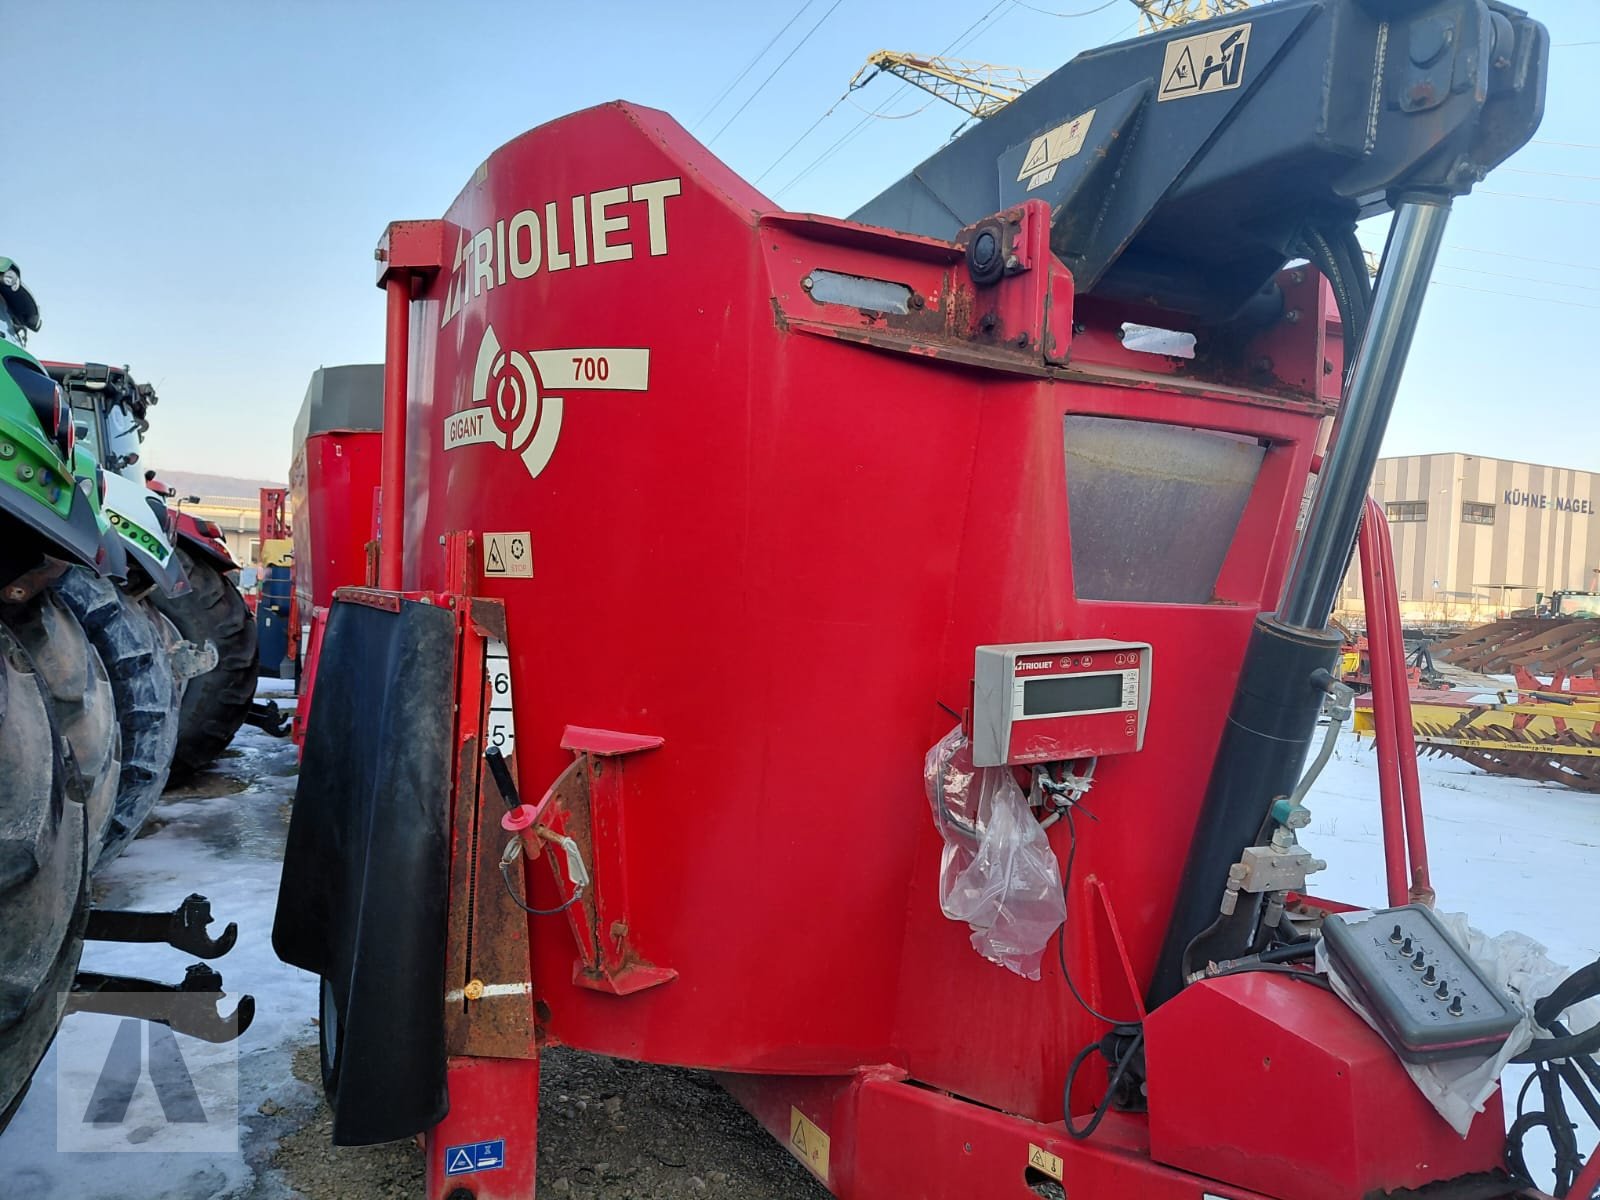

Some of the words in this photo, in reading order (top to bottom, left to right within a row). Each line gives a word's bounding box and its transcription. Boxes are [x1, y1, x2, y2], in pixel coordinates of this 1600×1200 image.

[462, 177, 681, 305] TRIOLIET
[572, 357, 609, 381] 700
[450, 414, 484, 441] GIGANT
[1022, 661, 1054, 670] TRIOLIET
[494, 673, 509, 694] 6
[492, 725, 506, 746] 5
